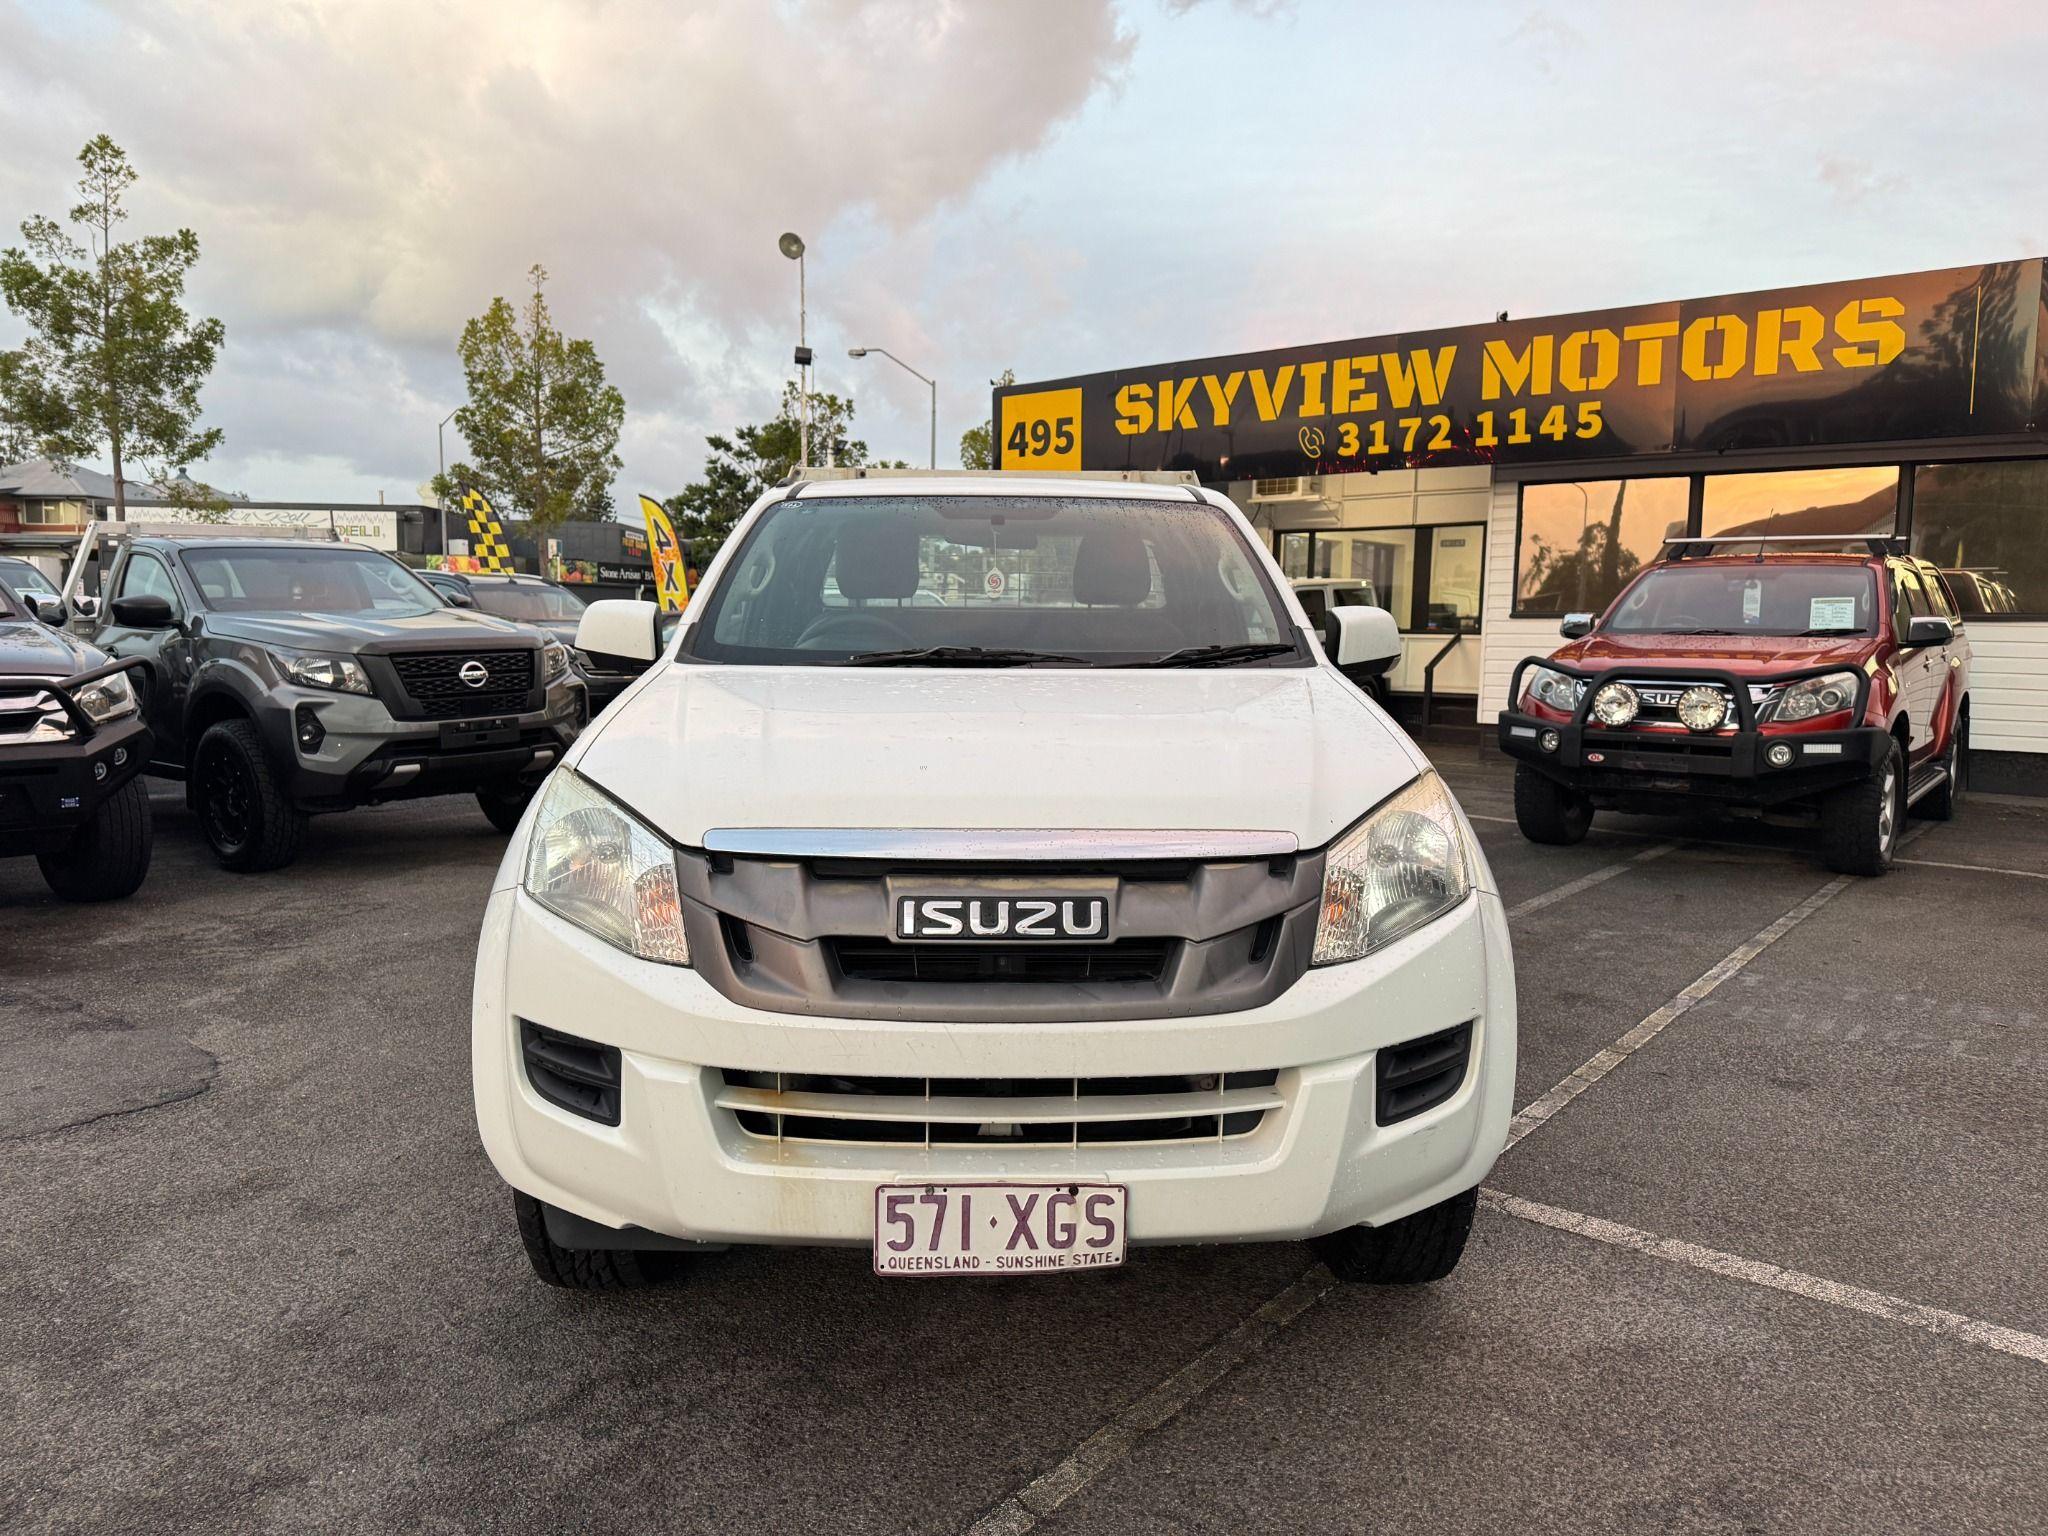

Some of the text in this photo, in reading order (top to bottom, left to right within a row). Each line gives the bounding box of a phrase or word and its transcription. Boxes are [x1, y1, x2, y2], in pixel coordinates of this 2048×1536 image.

[1115, 296, 1906, 436] SKYVIEW MOTORS
[1007, 416, 1075, 458] 495
[1337, 400, 1603, 457] 3172 1145
[1638, 693, 1681, 705] SUZ
[903, 900, 1102, 935] ISUZU
[886, 1193, 1116, 1252] 571 XGS
[888, 1255, 980, 1270] QUEENSLAND
[996, 1254, 1065, 1269] SUNSHINE
[1072, 1251, 1113, 1266] STATE
